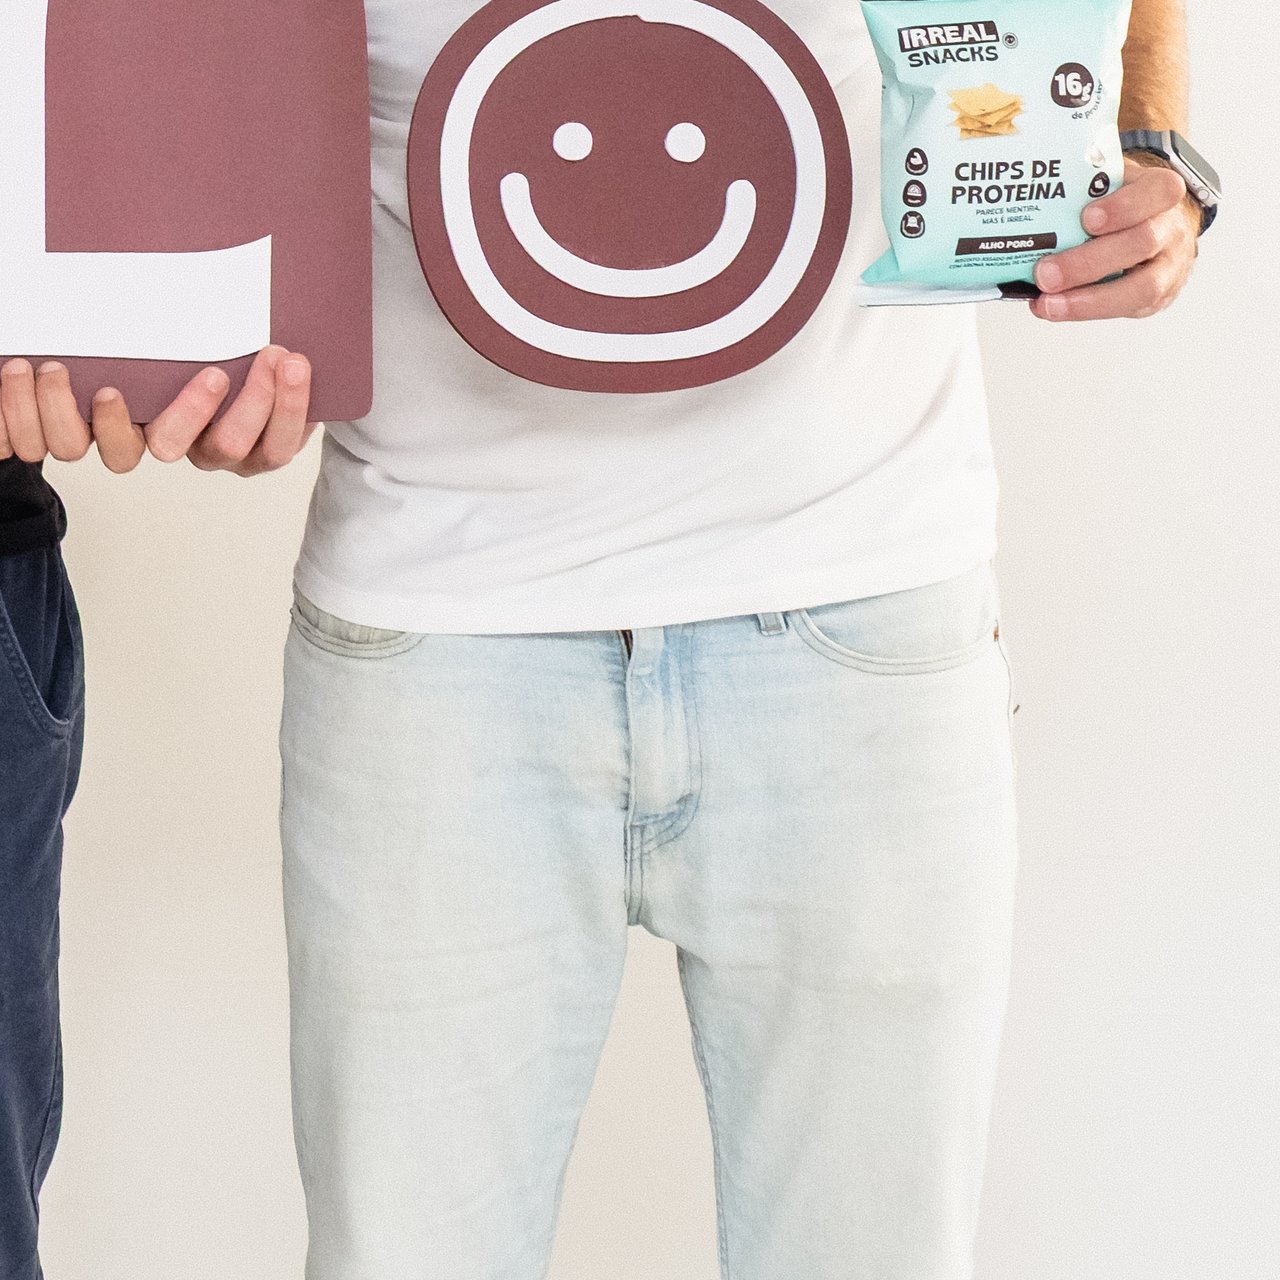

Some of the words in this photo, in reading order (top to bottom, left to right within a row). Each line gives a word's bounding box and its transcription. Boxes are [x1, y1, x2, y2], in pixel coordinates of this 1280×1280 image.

[900, 22, 997, 50] IRREAL
[907, 46, 1000, 68] SNACKS
[1054, 71, 1093, 102] 16g
[954, 160, 1024, 182] CHIPS
[1030, 159, 1062, 179] DE
[951, 180, 1066, 205] PROTEÍNA
[979, 240, 1005, 250] ALHO
[1006, 237, 1034, 249] PORÓ
